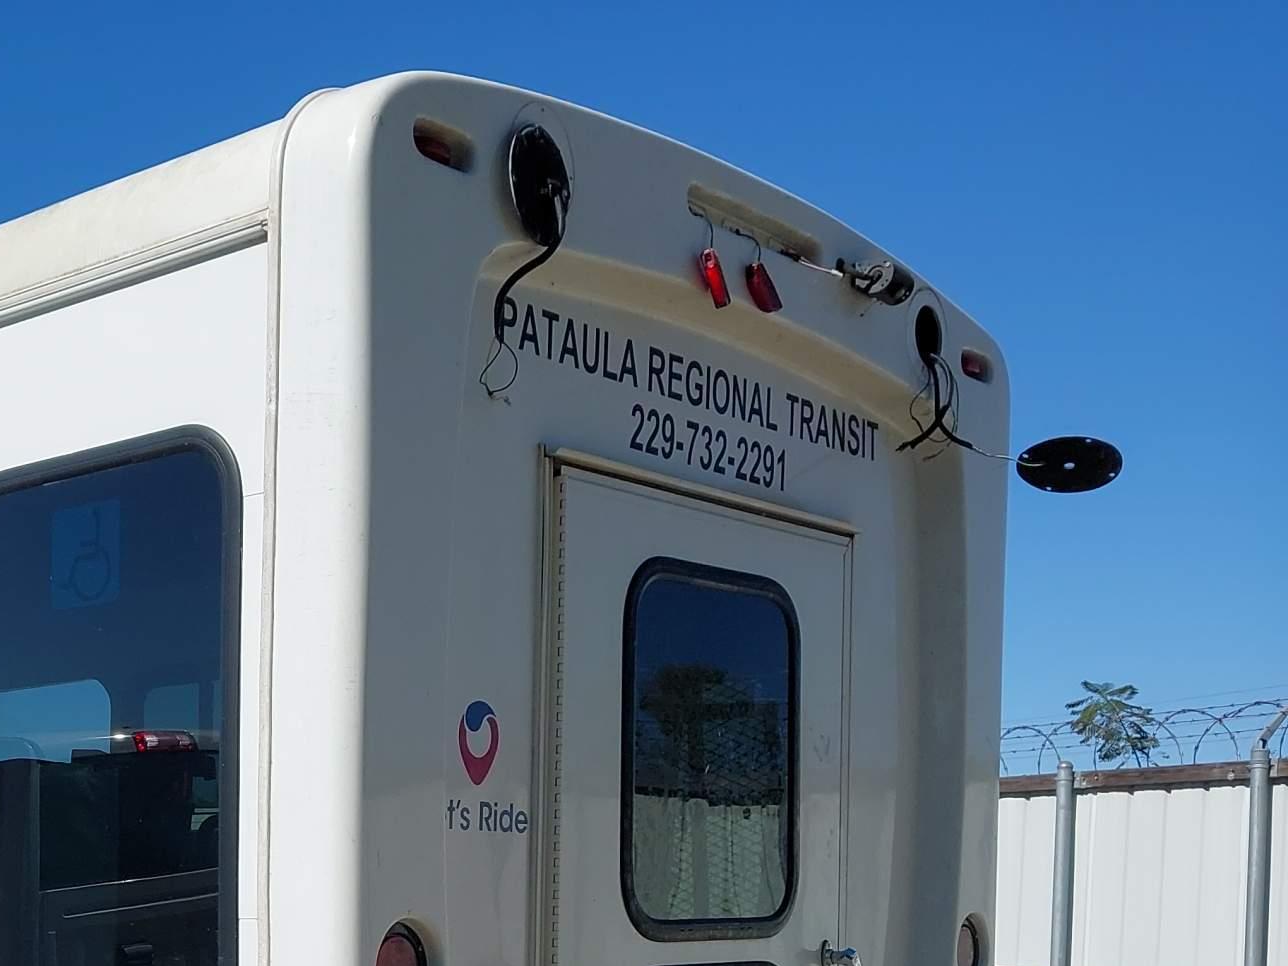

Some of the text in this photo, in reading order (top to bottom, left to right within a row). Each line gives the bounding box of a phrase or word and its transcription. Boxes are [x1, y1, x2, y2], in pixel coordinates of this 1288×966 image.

[499, 296, 879, 461] PATAULA REGIONAL TRANSIT
[629, 404, 786, 491] 229-732-2291
[445, 799, 528, 833] t's Ride
